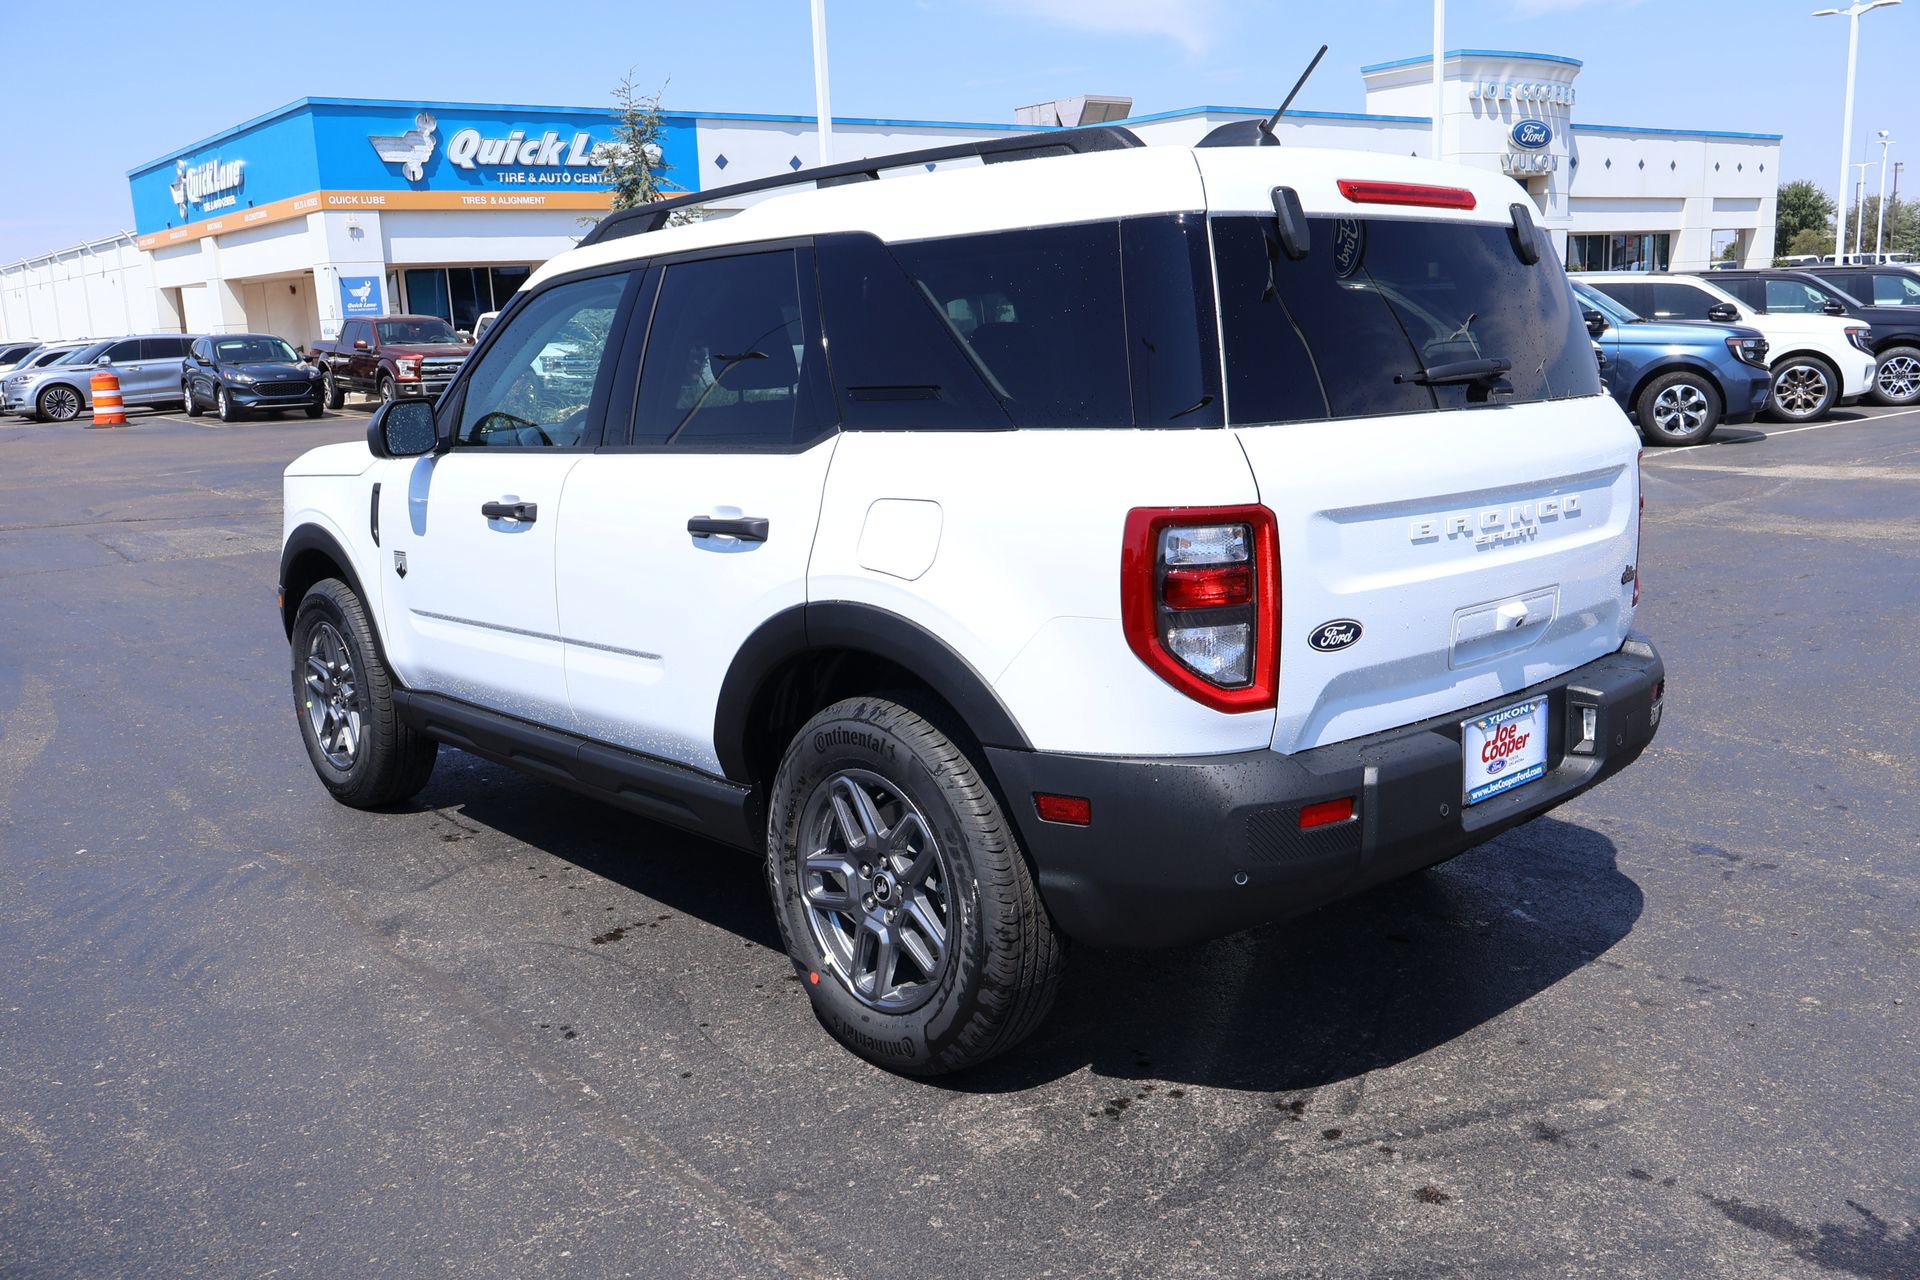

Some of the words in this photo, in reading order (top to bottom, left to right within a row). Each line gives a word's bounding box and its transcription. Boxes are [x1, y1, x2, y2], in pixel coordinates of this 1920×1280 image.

[1471, 81, 1513, 99] JOE
[1516, 83, 1575, 105] COOPER
[448, 127, 569, 170] Quick
[1505, 154, 1558, 172] YUKON
[213, 159, 241, 192] Lane
[496, 172, 526, 183] TIRE
[528, 172, 537, 183] &
[538, 172, 571, 184] AUTO
[328, 195, 358, 205] QUICK
[360, 195, 386, 205] LUBE
[461, 196, 487, 205] TIRES
[490, 196, 497, 205] &
[498, 196, 546, 205] ALIGNMENT
[1408, 494, 1582, 540] BRONCO
[1474, 525, 1538, 545] SPORT
[1320, 624, 1355, 647] Ford
[1489, 704, 1529, 724] YUKON
[814, 726, 887, 754] Continental
[1492, 723, 1517, 746] Joe
[1481, 733, 1530, 763] Cooper
